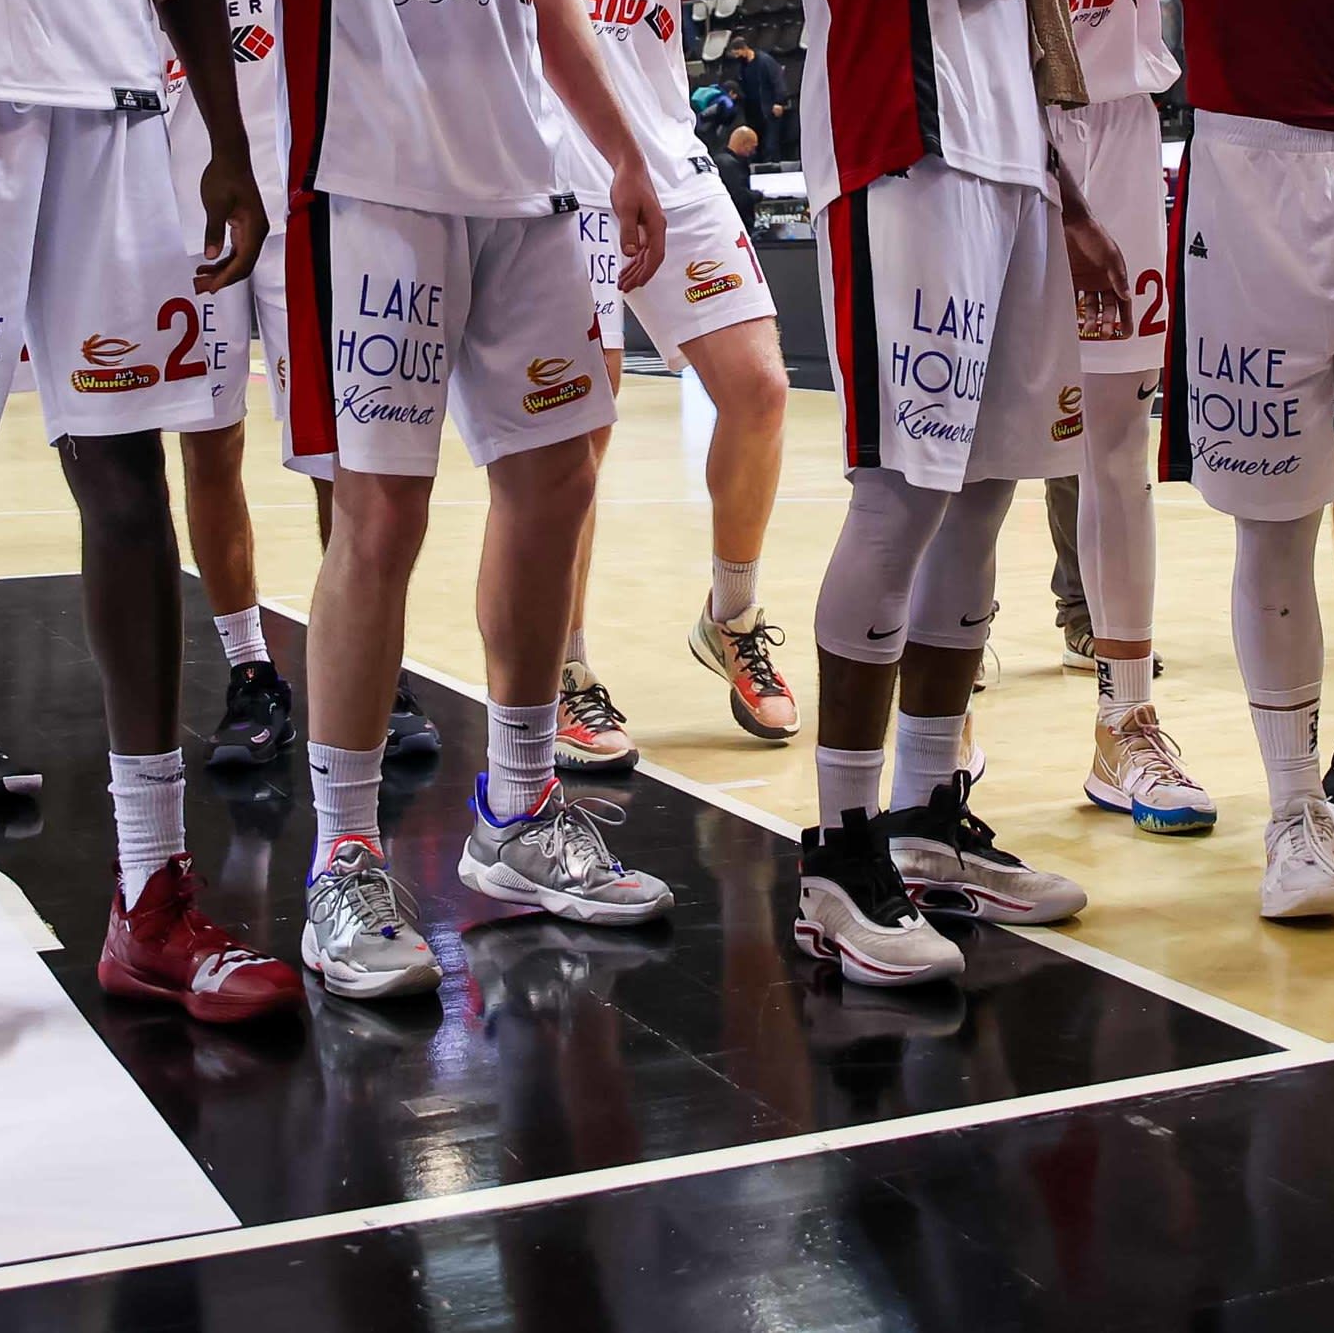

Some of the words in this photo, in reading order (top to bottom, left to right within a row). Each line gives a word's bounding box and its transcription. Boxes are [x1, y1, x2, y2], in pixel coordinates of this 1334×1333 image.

[579, 211, 610, 243] KE
[589, 254, 616, 284] USE
[359, 274, 442, 327] LAKE
[693, 283, 727, 299] Winner
[913, 288, 985, 344] LAKE
[157, 296, 208, 382] 2
[337, 329, 444, 385] HOUSE
[80, 374, 136, 389] Winner
[892, 342, 987, 403] HOUSE
[1198, 337, 1287, 388] LAKE
[334, 384, 434, 425] Kinneret
[531, 389, 577, 411] Winner
[1190, 393, 1302, 438] HOUSE
[1058, 422, 1082, 438] Winn
[1189, 436, 1301, 477] Kinneret
